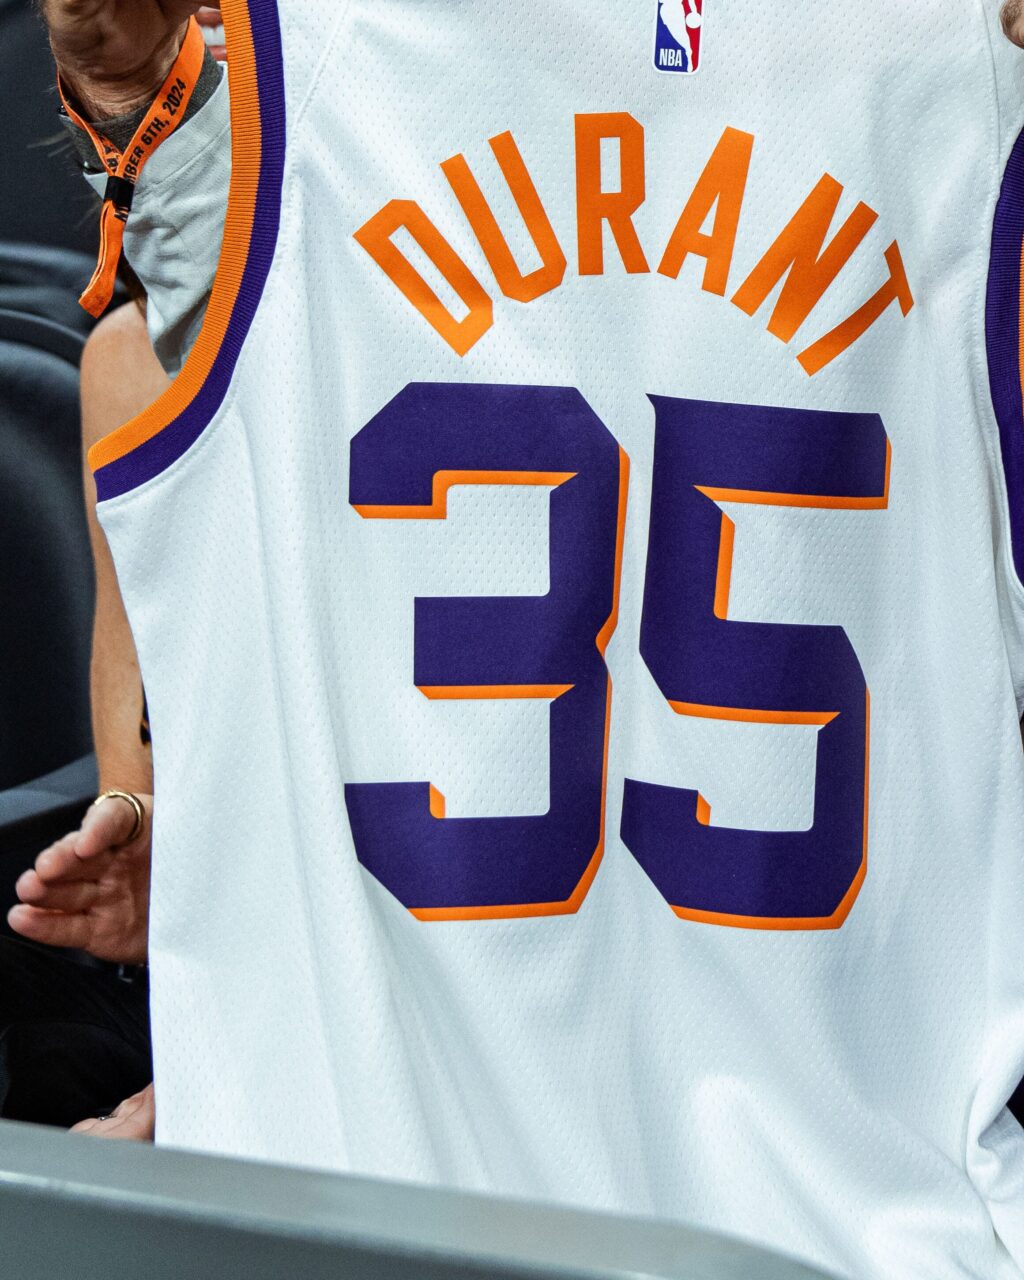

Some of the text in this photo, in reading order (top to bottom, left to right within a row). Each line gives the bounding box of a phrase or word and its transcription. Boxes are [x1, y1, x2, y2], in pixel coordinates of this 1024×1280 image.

[141, 117, 170, 146] 6TH,
[162, 78, 186, 116] 2024
[658, 48, 683, 67] NBA
[352, 111, 915, 377] DURANT
[344, 381, 892, 931] 35
